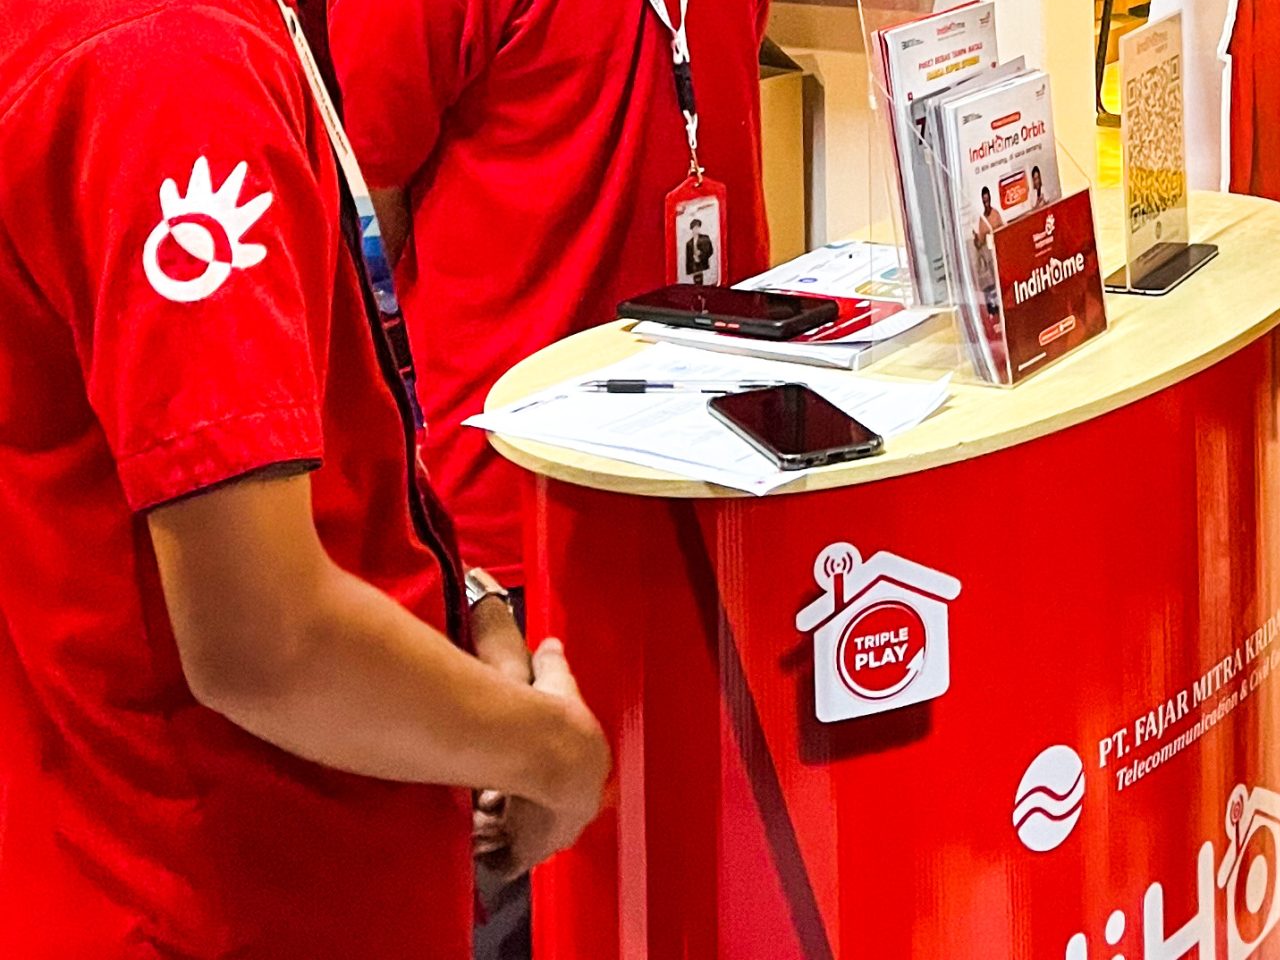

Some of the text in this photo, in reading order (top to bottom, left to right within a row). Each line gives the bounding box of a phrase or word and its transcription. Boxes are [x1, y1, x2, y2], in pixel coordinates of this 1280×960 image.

[969, 120, 1046, 163] IndiHome Orbit
[1014, 252, 1085, 304] IndiHome
[853, 627, 910, 650] TRIPLE
[854, 644, 910, 672] PLAY
[1099, 728, 1130, 768] PT.
[1135, 690, 1189, 747] FAJAR
[1193, 647, 1243, 707] MITRA
[1116, 692, 1238, 791] Telecommunication
[1239, 679, 1248, 701] &
